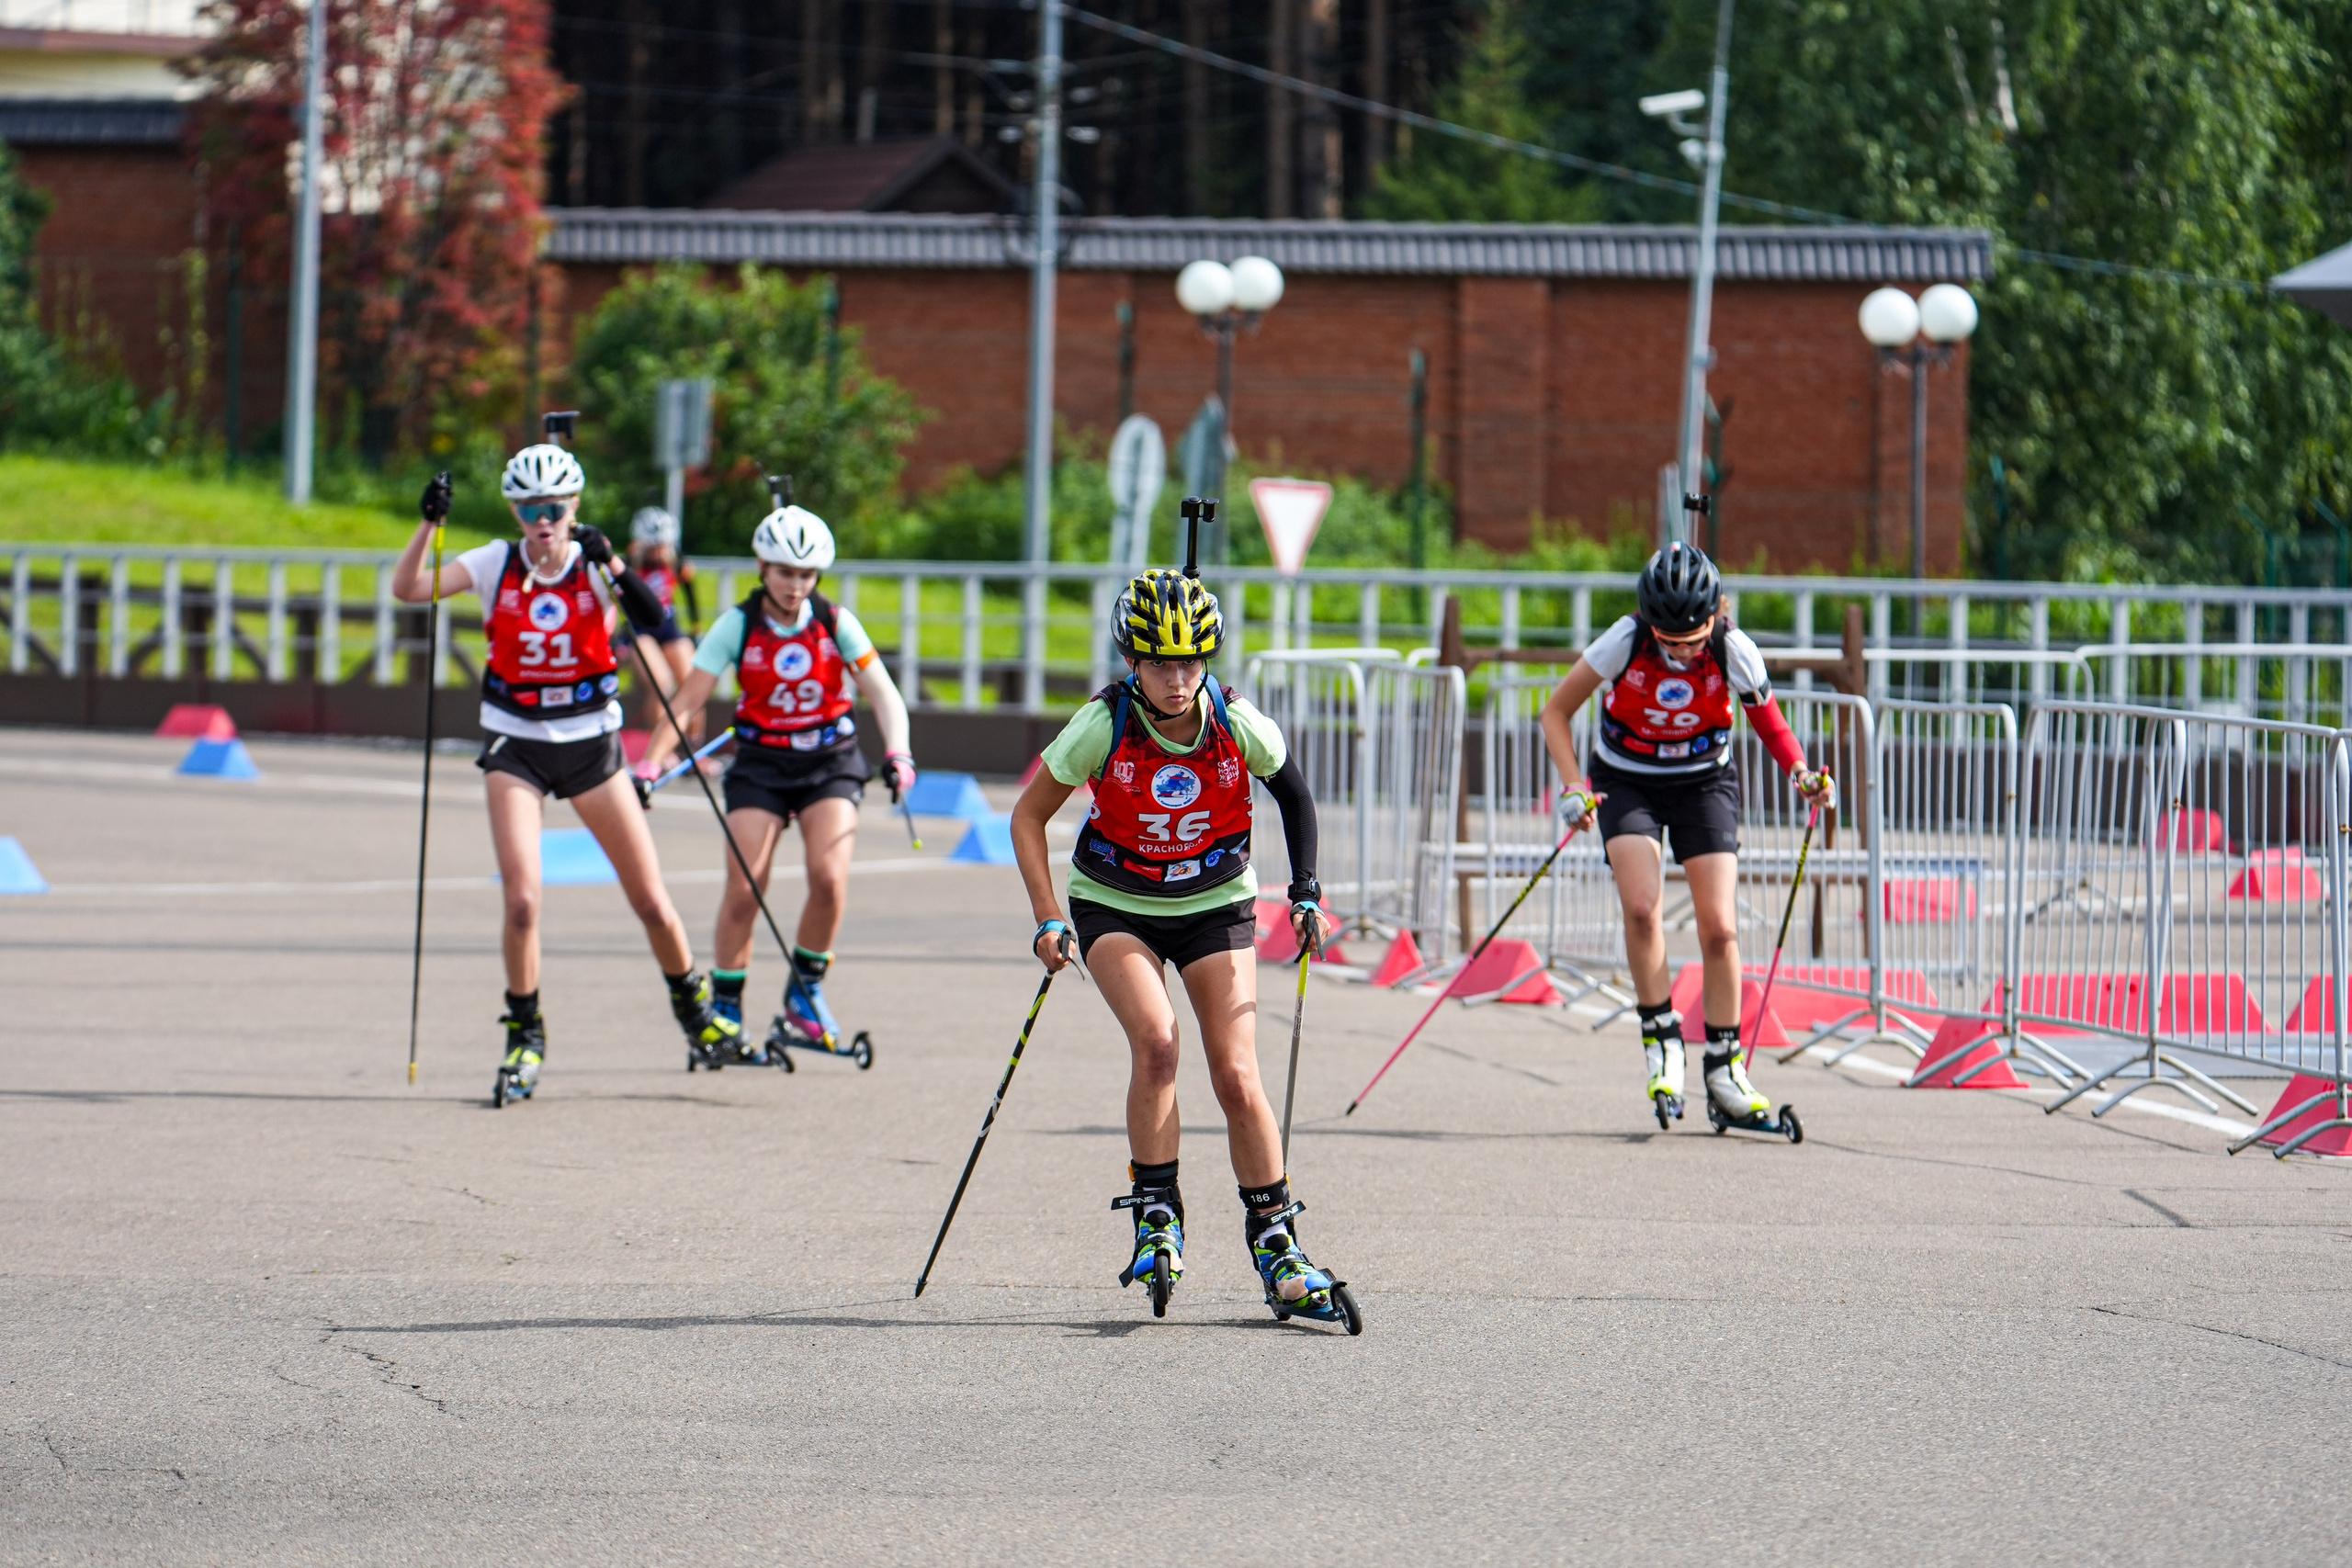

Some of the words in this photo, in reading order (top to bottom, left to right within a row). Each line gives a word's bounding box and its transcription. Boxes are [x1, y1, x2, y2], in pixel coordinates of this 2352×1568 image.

[518, 631, 579, 668] 31
[767, 679, 824, 714] 49
[1138, 810, 1211, 841] 36
[1119, 1195, 1156, 1207] SPINE
[1250, 1193, 1270, 1203] 186
[1271, 1204, 1299, 1224] SPINE
